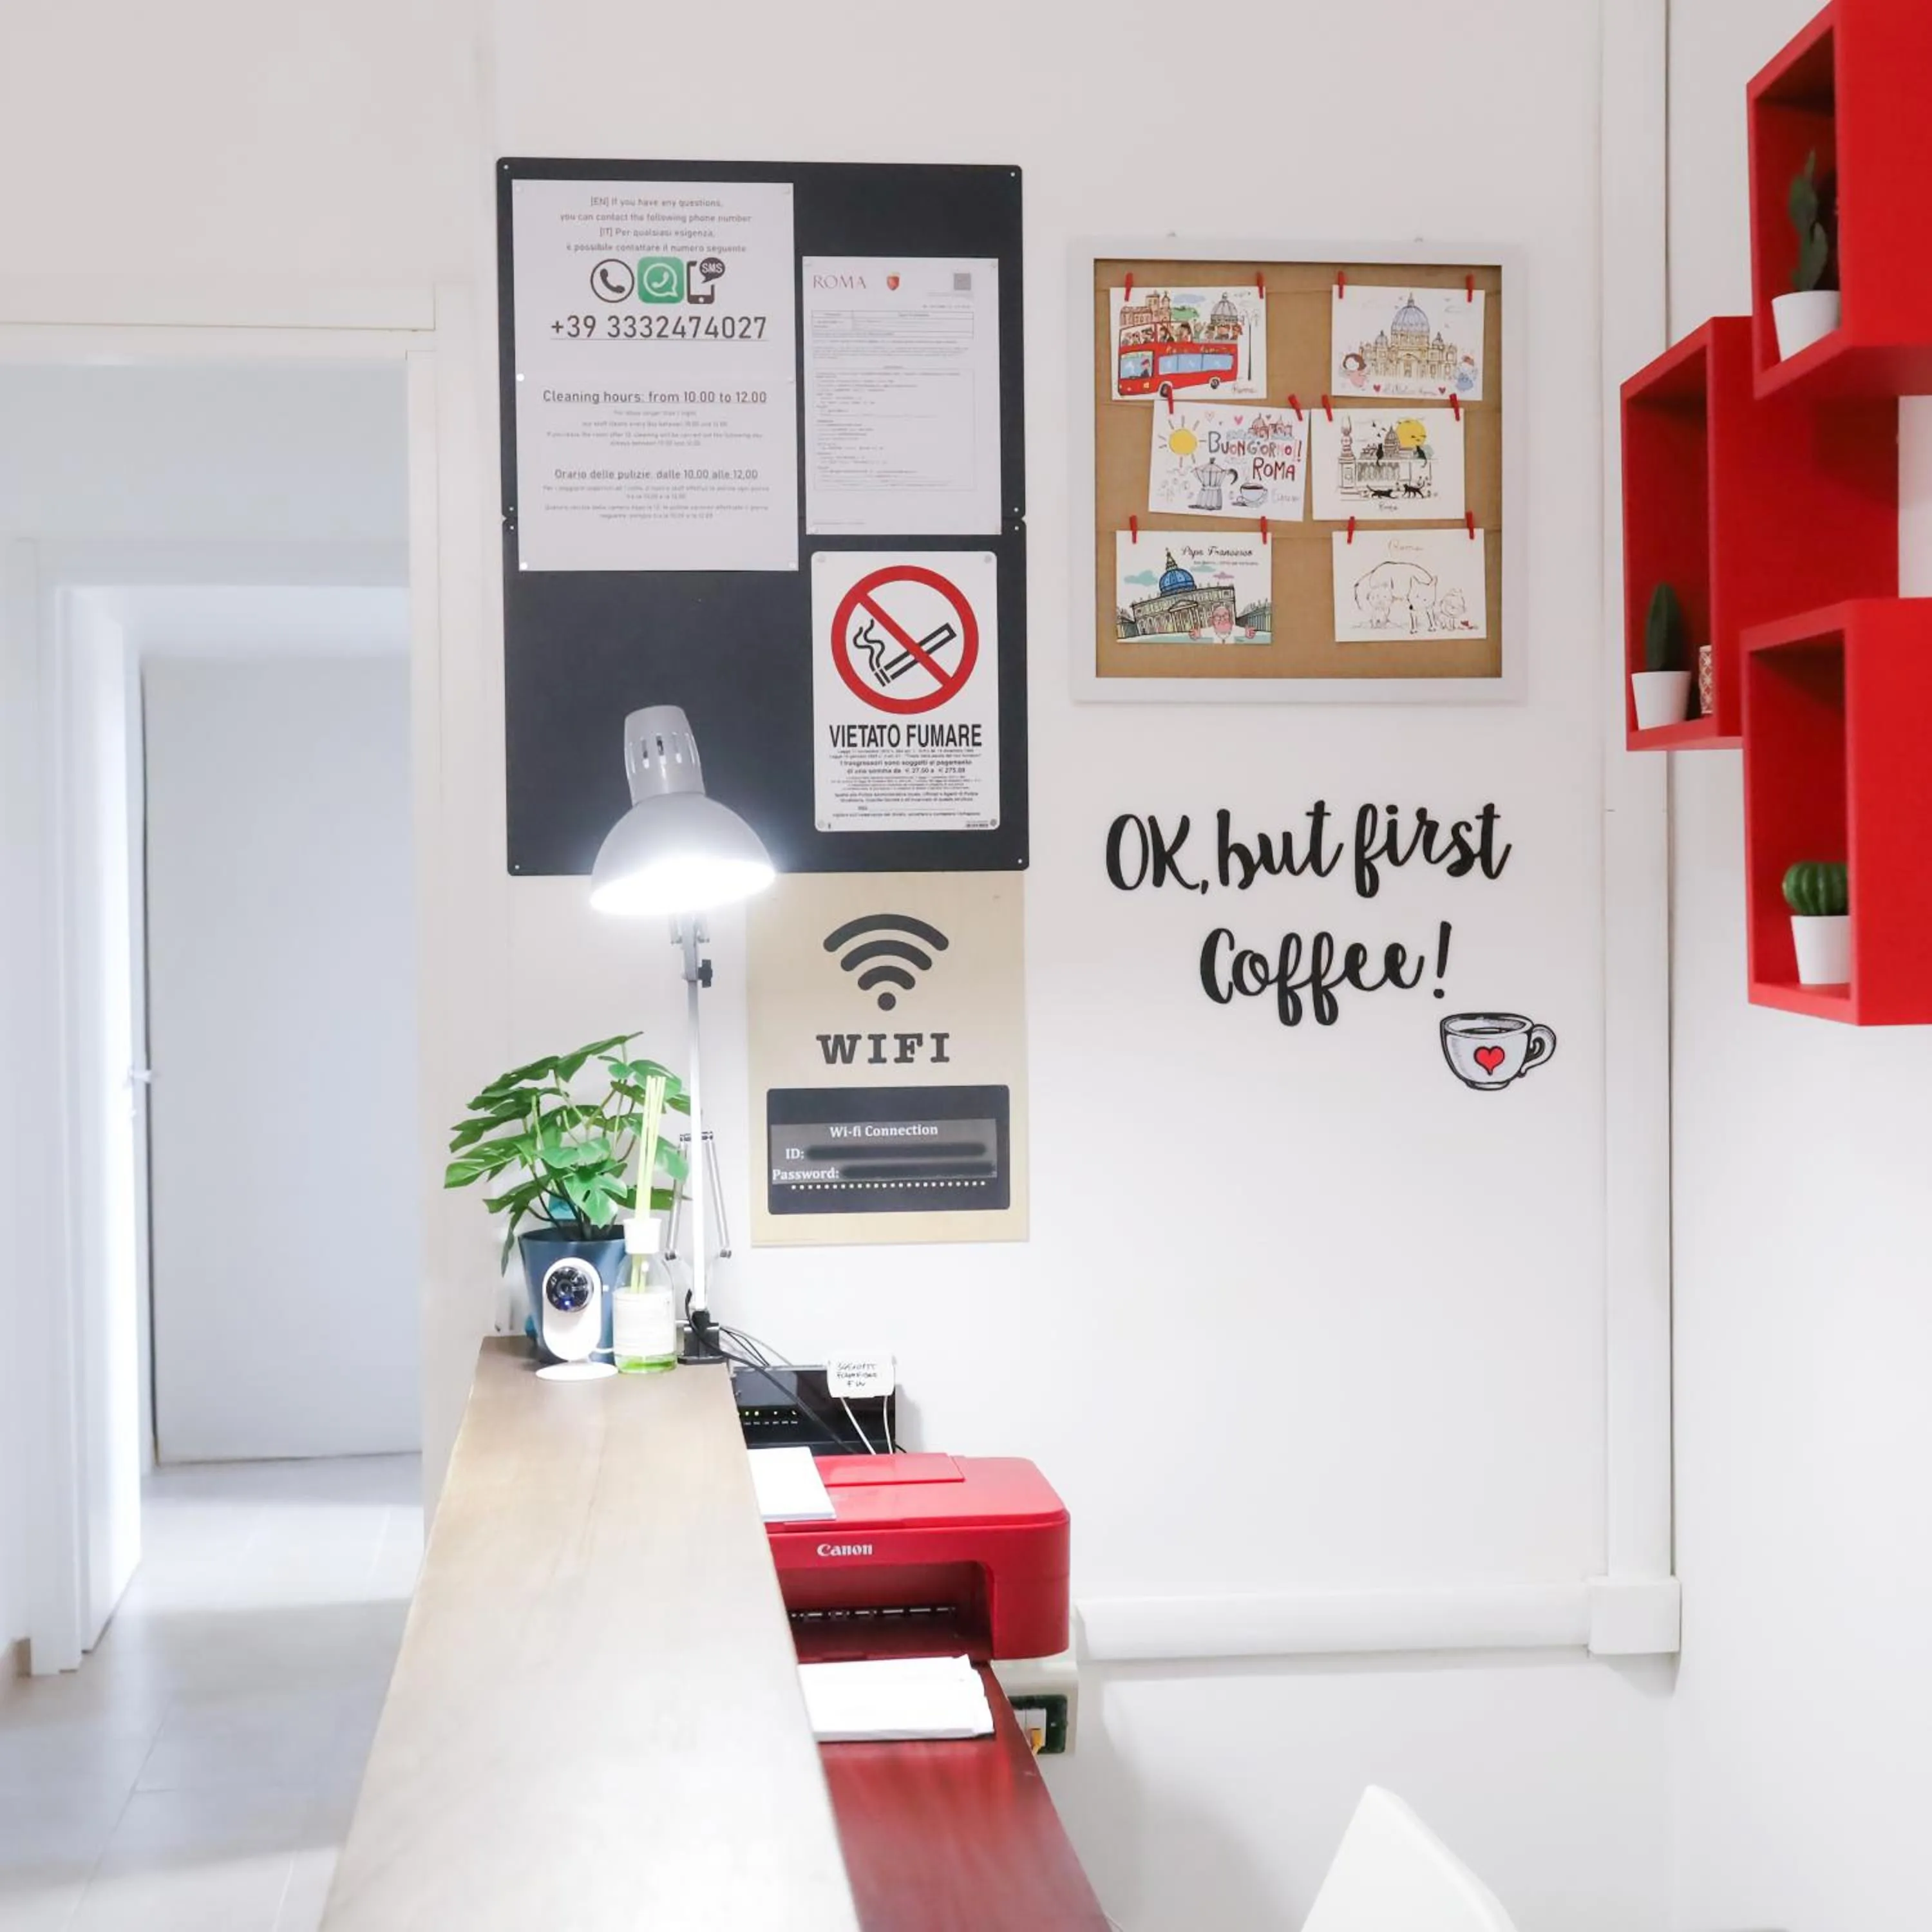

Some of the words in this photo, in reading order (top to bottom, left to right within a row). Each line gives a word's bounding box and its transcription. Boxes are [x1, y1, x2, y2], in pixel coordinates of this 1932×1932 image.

[620, 198, 636, 207] you
[638, 198, 658, 207] have
[661, 199, 677, 208] any
[560, 214, 577, 222] you
[596, 213, 629, 222] contact
[630, 213, 644, 222] the
[646, 213, 687, 223] following
[689, 214, 716, 223] phone
[718, 214, 752, 223] number
[615, 228, 630, 236] Per
[633, 228, 673, 238] qualsiasi
[574, 243, 613, 253] possibile
[616, 244, 661, 253] contattare
[706, 245, 746, 255] seguente
[701, 263, 723, 274] SMS
[813, 274, 866, 290] ROMA
[551, 315, 597, 338] +39
[607, 316, 767, 339] 3332474027
[543, 390, 600, 404] Cleaning
[649, 392, 680, 403] from
[684, 392, 715, 403] 10.00
[719, 392, 732, 403] to
[736, 392, 767, 403] 12.00
[554, 469, 587, 480] Orario
[590, 469, 614, 480] delle
[656, 470, 681, 480] dalle
[829, 724, 901, 748] VIETATO
[906, 724, 982, 748] FUMARE
[1218, 800, 1344, 890] but
[1355, 802, 1512, 898] first
[817, 1032, 950, 1065] WIFI
[829, 1125, 861, 1138] Wi-fi
[865, 1124, 938, 1137] Connection
[786, 1148, 804, 1160] ID:
[772, 1168, 839, 1181] Password:
[817, 1544, 873, 1557] Canon
